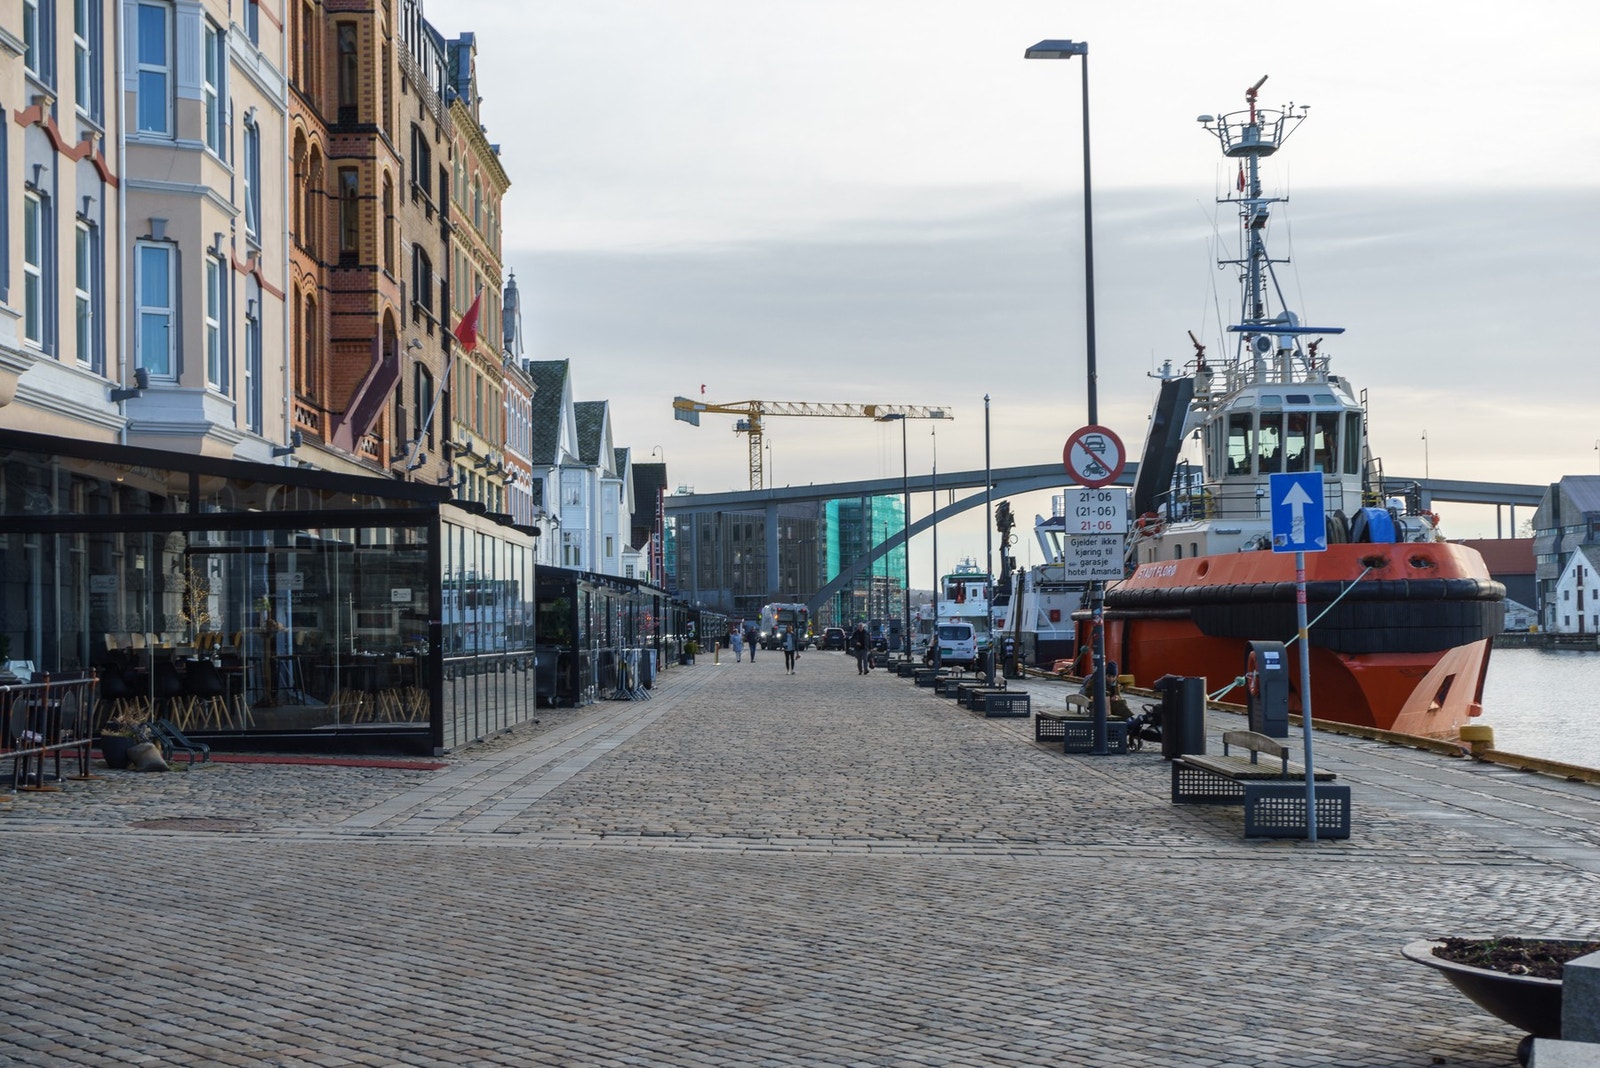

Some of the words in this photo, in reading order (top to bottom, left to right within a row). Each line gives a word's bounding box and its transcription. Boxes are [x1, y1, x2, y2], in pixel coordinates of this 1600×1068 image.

[1080, 492, 1112, 502] 21-06
[1076, 506, 1116, 516] (21-06)
[1081, 521, 1111, 531] 21-06
[1071, 539, 1097, 548] Gjelder
[1076, 548, 1101, 558] kjøring
[1080, 559, 1108, 568] garasje
